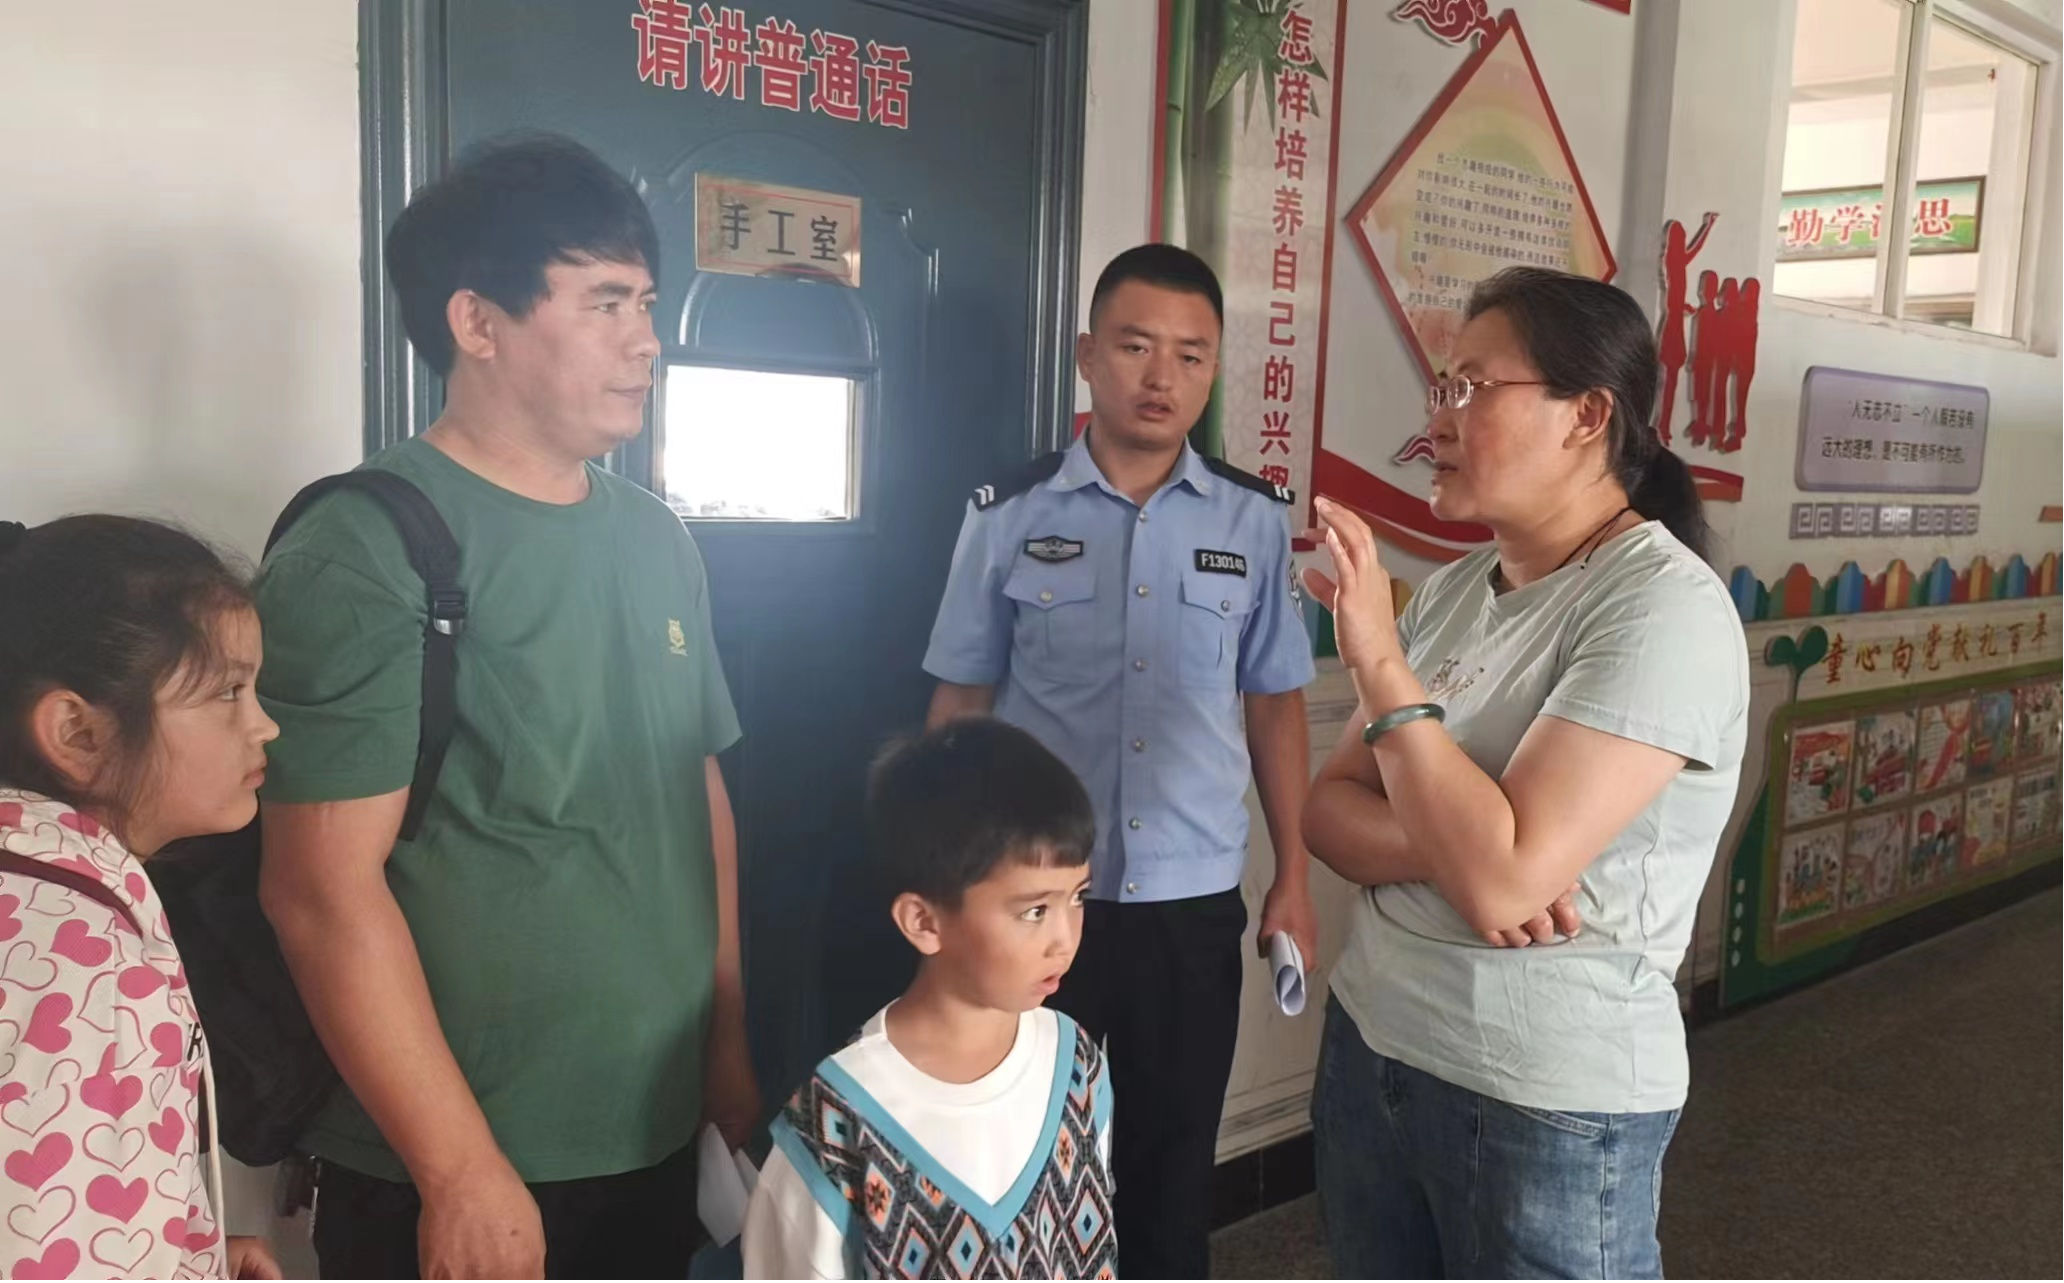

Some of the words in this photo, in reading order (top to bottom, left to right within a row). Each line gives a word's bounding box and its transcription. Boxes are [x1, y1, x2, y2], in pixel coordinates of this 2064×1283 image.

[631, 0, 912, 129] 请讲普通话
[720, 201, 838, 262] 手工室
